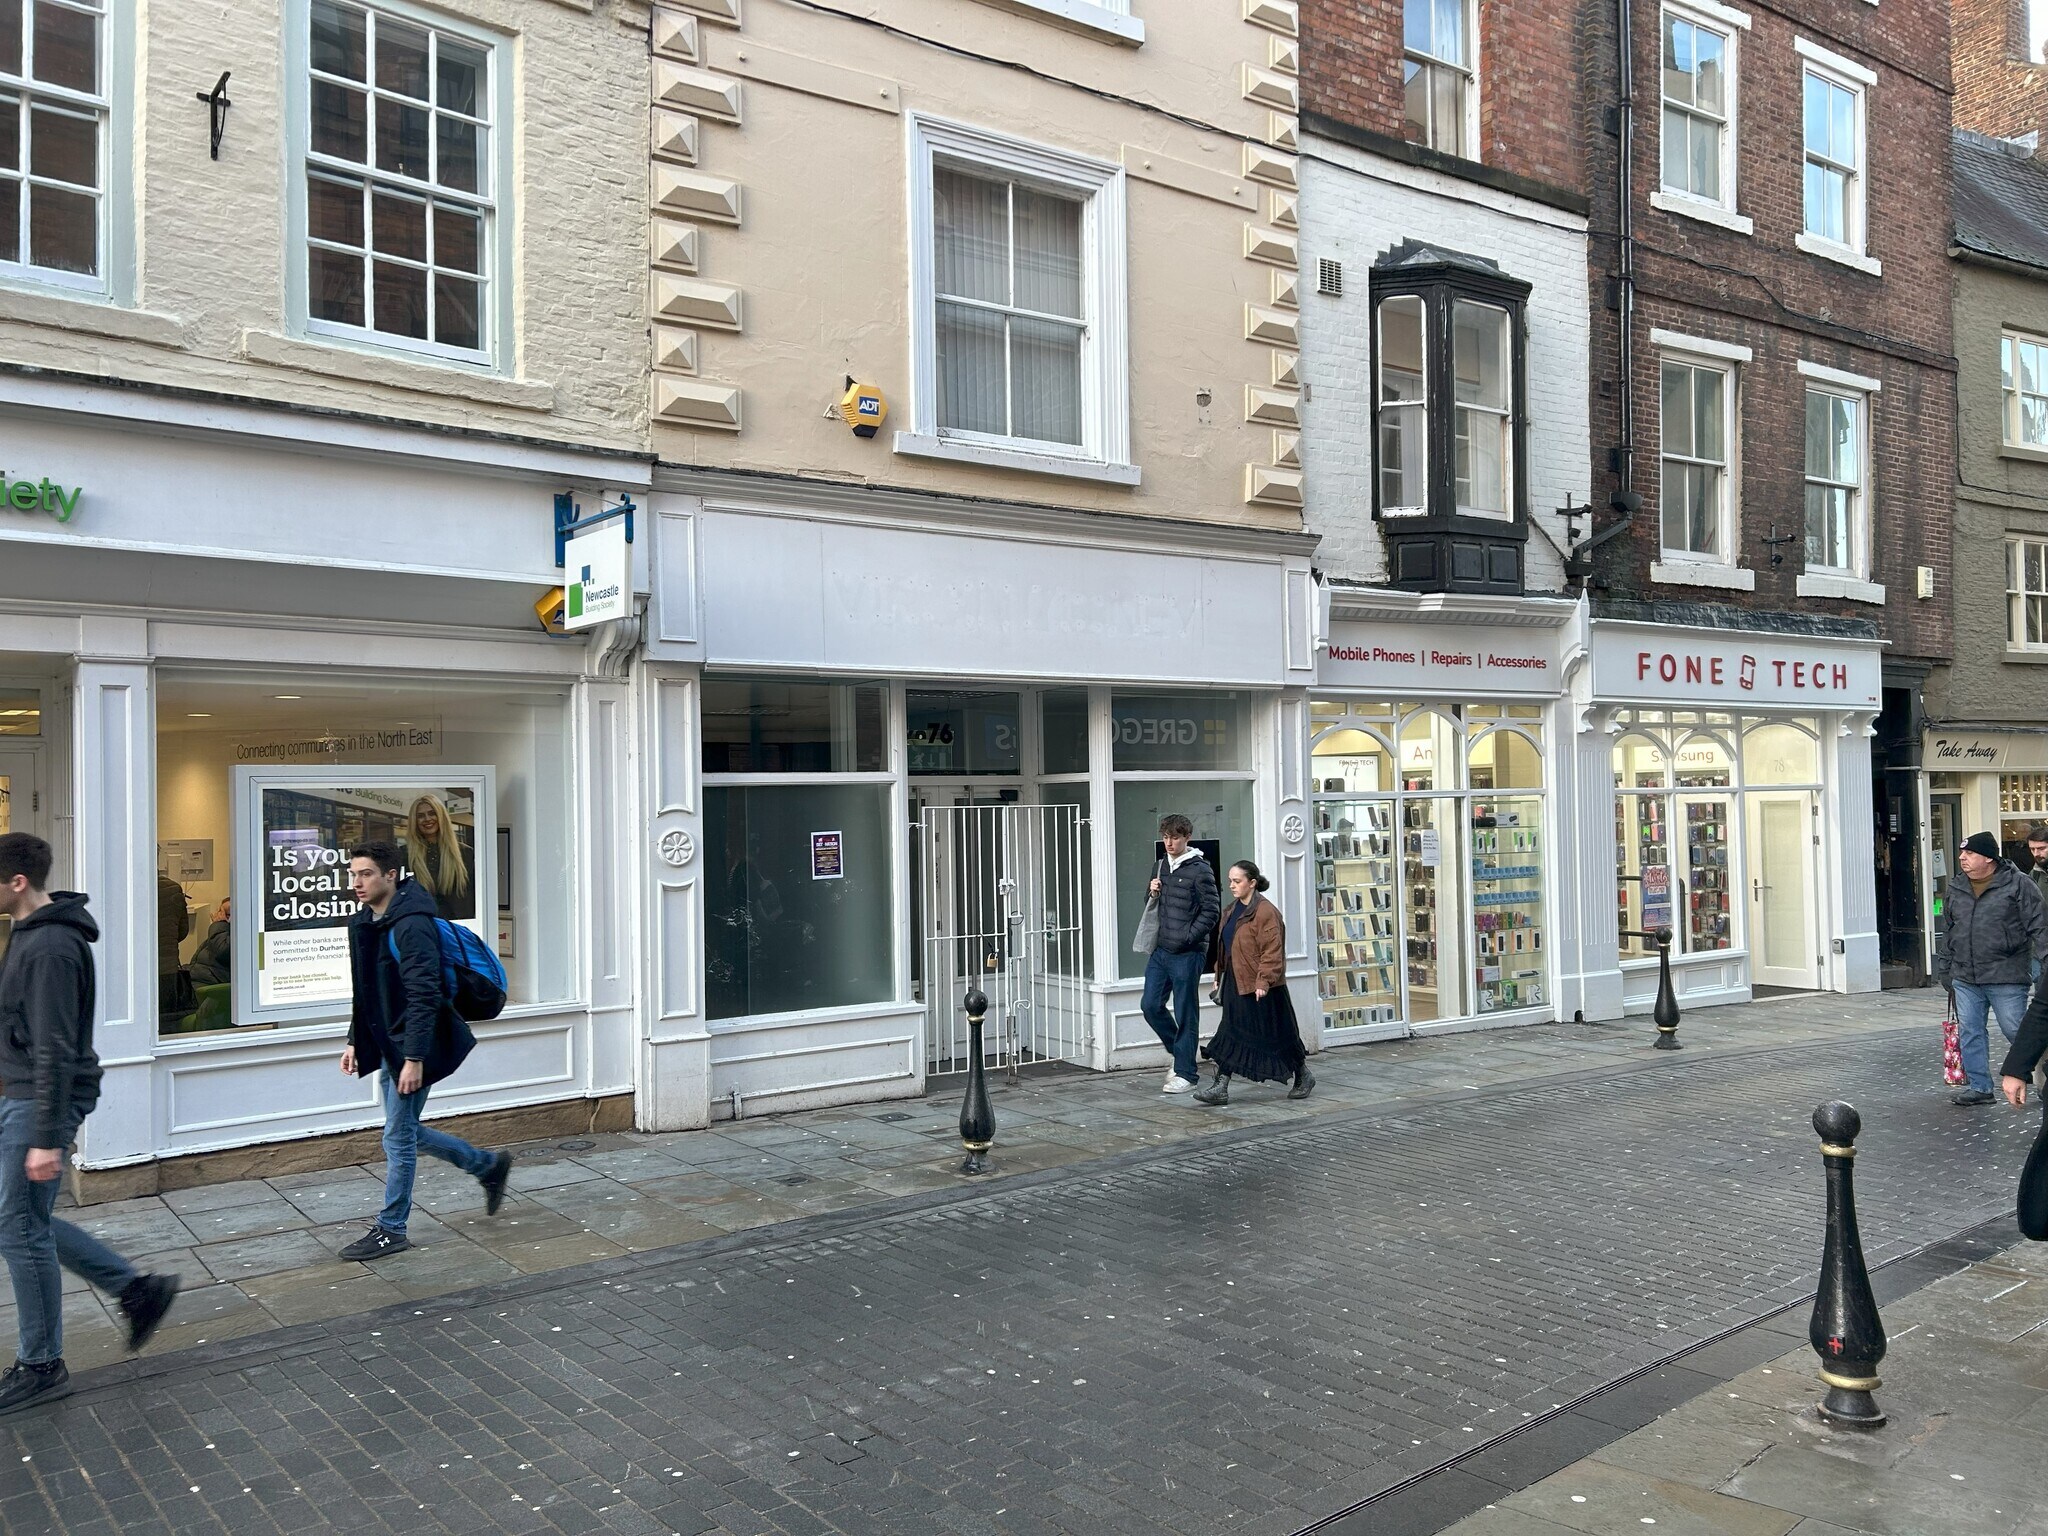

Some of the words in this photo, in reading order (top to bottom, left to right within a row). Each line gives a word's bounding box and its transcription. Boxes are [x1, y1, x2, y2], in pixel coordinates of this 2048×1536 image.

[859, 400, 880, 412] ADT
[585, 584, 619, 603] Newcastle
[585, 602, 601, 613] Building
[601, 600, 616, 609] Society
[1328, 646, 1370, 662] Mobile
[1373, 648, 1415, 663] Phones
[1431, 651, 1473, 667] Repairs
[1487, 654, 1547, 669] Accessories
[1637, 652, 1724, 685] FONE
[1772, 660, 1847, 690] TECH
[236, 742, 286, 760] Connecting
[347, 735, 357, 750] in
[359, 734, 375, 749] the
[377, 730, 406, 748] North
[409, 728, 433, 746] East
[1936, 740, 1962, 759] Take
[1963, 740, 1998, 763] Away
[355, 788, 382, 804] Building
[382, 795, 404, 809] Society
[272, 845, 298, 867] Is
[304, 848, 352, 870] you
[272, 869, 343, 894] local
[272, 946, 310, 955] committed
[319, 944, 346, 952] Durham
[273, 939, 292, 947] While
[312, 936, 332, 944] banks
[285, 955, 315, 963] everyday
[316, 952, 344, 960] financial
